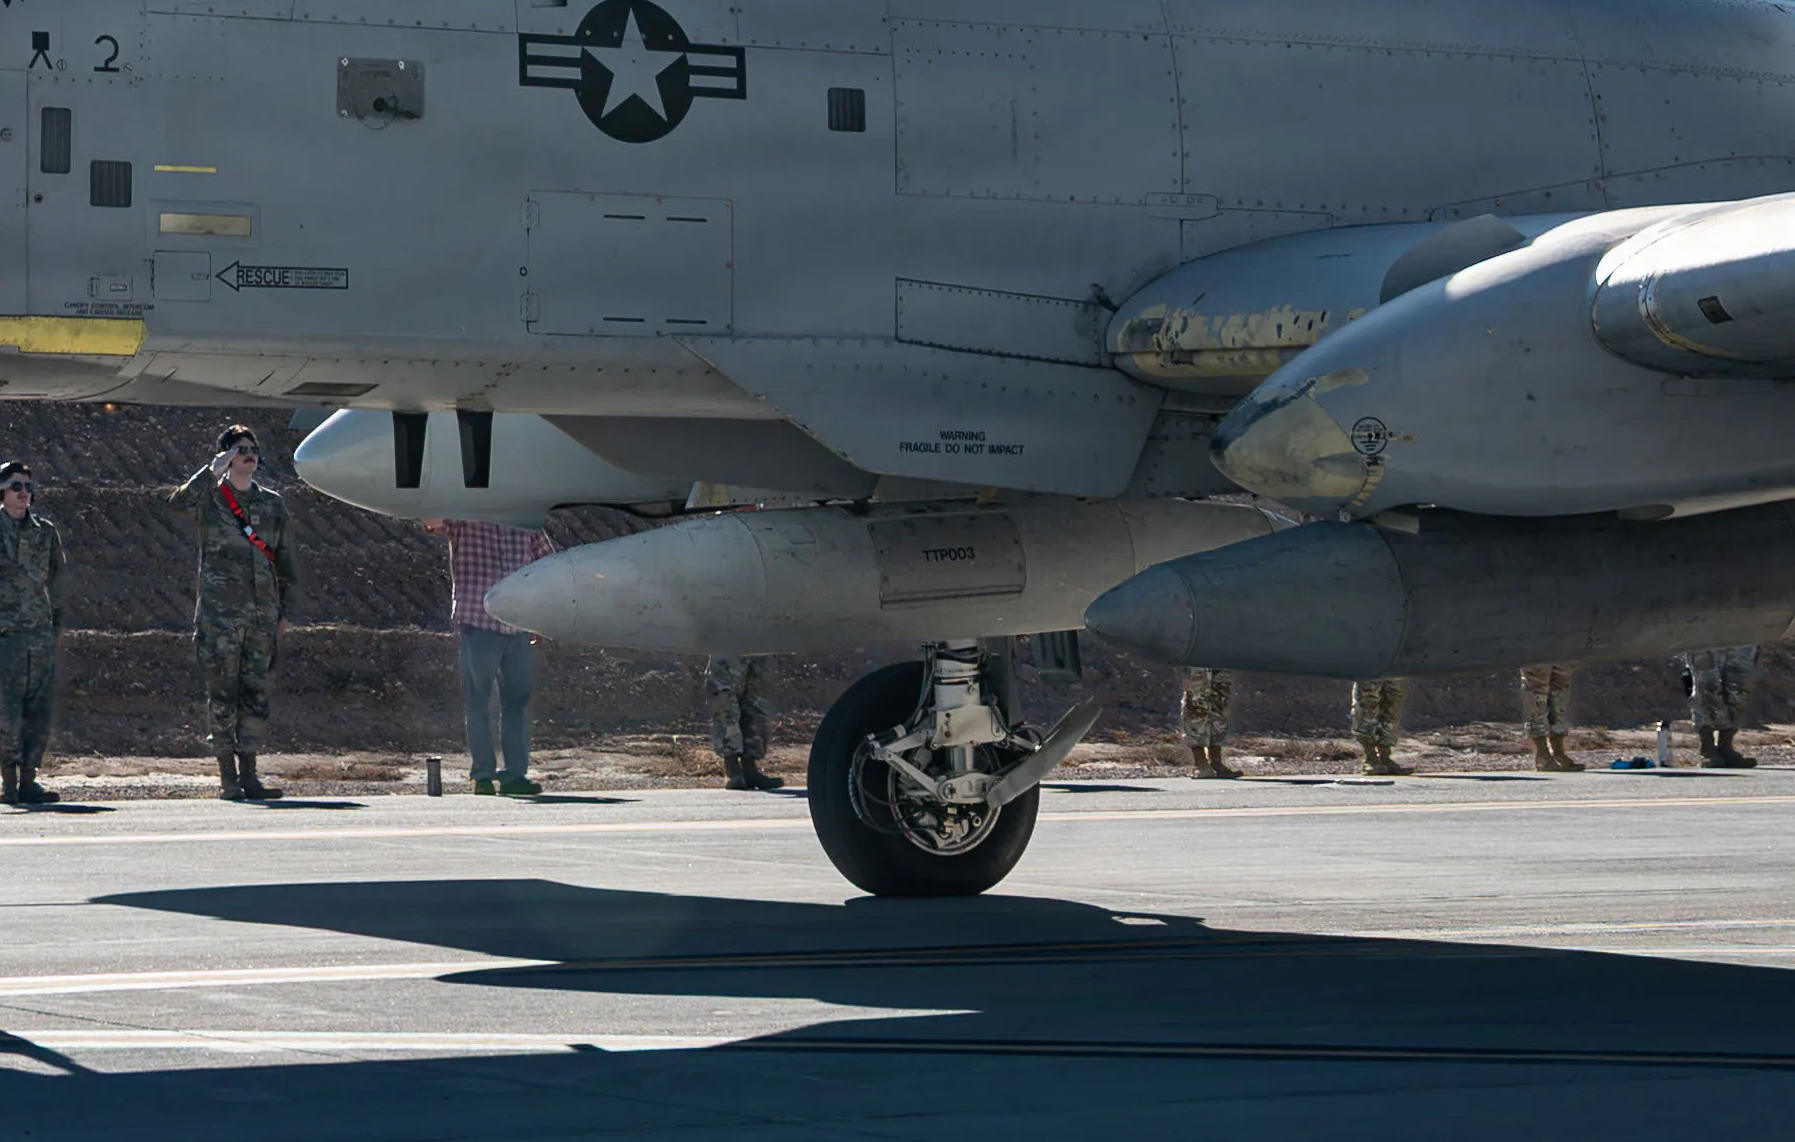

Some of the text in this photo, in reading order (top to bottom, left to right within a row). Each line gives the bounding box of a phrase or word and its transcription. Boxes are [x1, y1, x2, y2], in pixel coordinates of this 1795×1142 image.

[94, 35, 119, 72] 2
[236, 269, 290, 285] RESCUE
[940, 430, 986, 441] WARNING
[899, 442, 1025, 455] FRAGILE DO NOT IMPACT
[921, 546, 976, 562] TTP003
